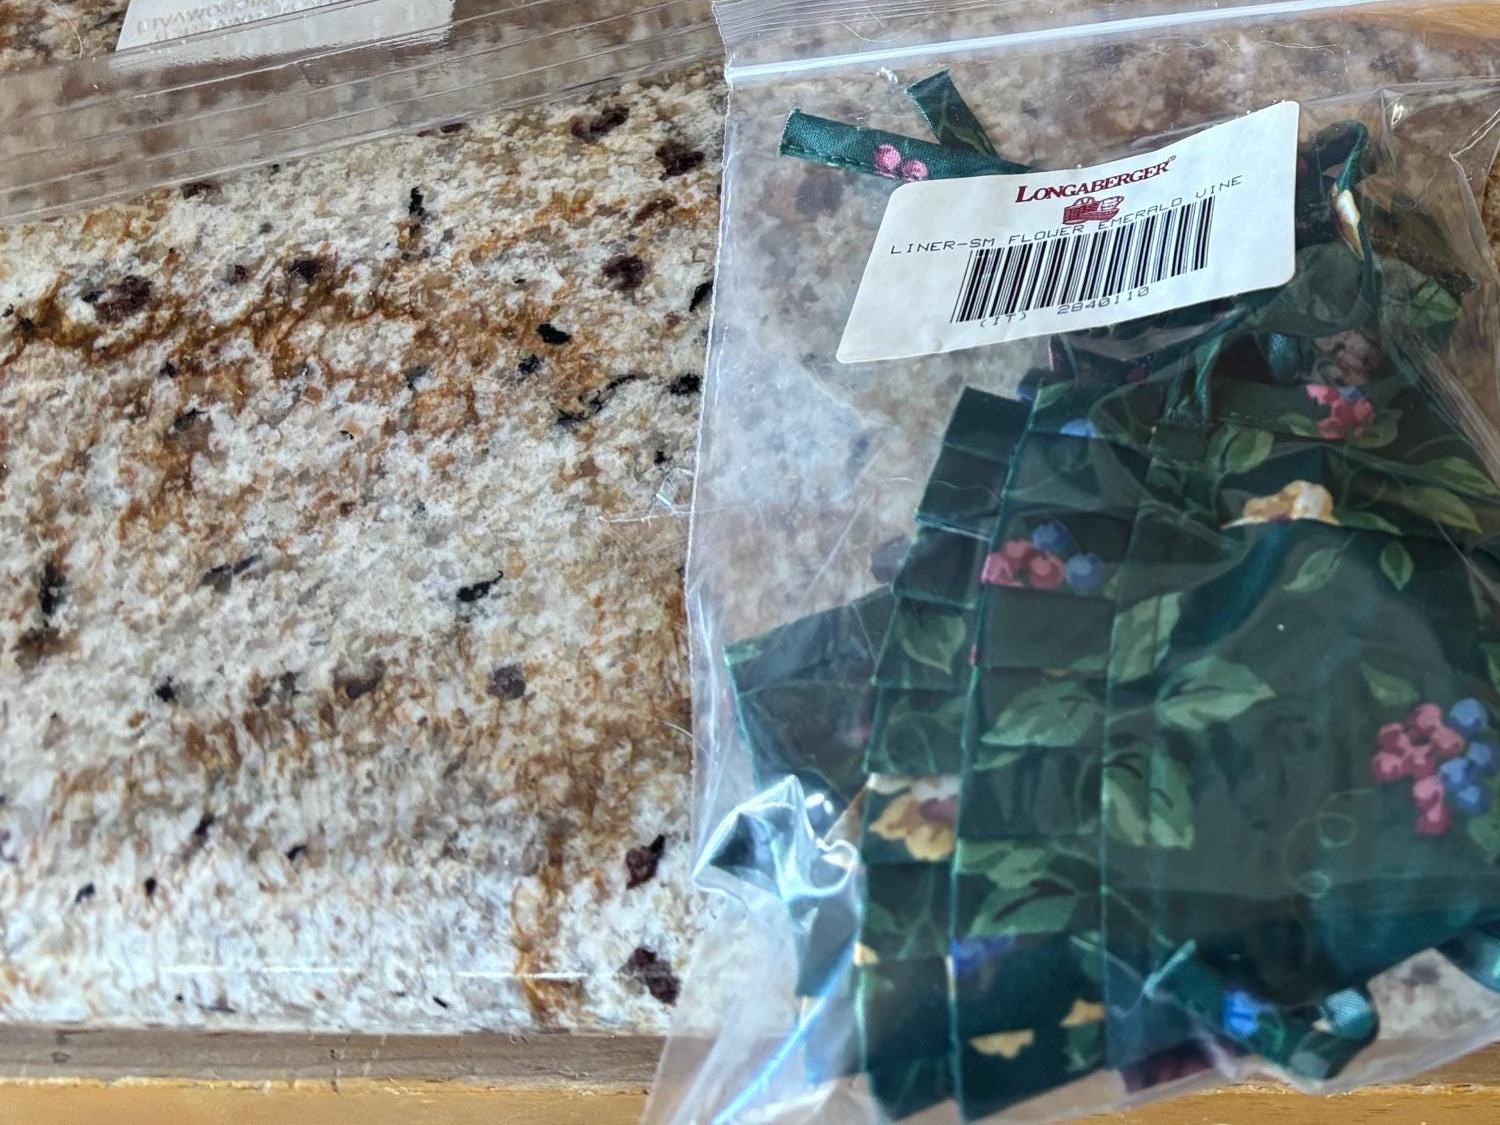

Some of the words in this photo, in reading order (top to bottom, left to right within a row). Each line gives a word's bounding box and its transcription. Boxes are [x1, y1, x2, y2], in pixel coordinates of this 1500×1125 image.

[890, 237, 995, 255] LINER-SM
[1009, 222, 1085, 245] FLOWER
[1098, 197, 1182, 230] EMERALD
[1195, 174, 1243, 200] VINE
[980, 312, 1027, 328] (IT)
[1057, 286, 1150, 315] 2840110
